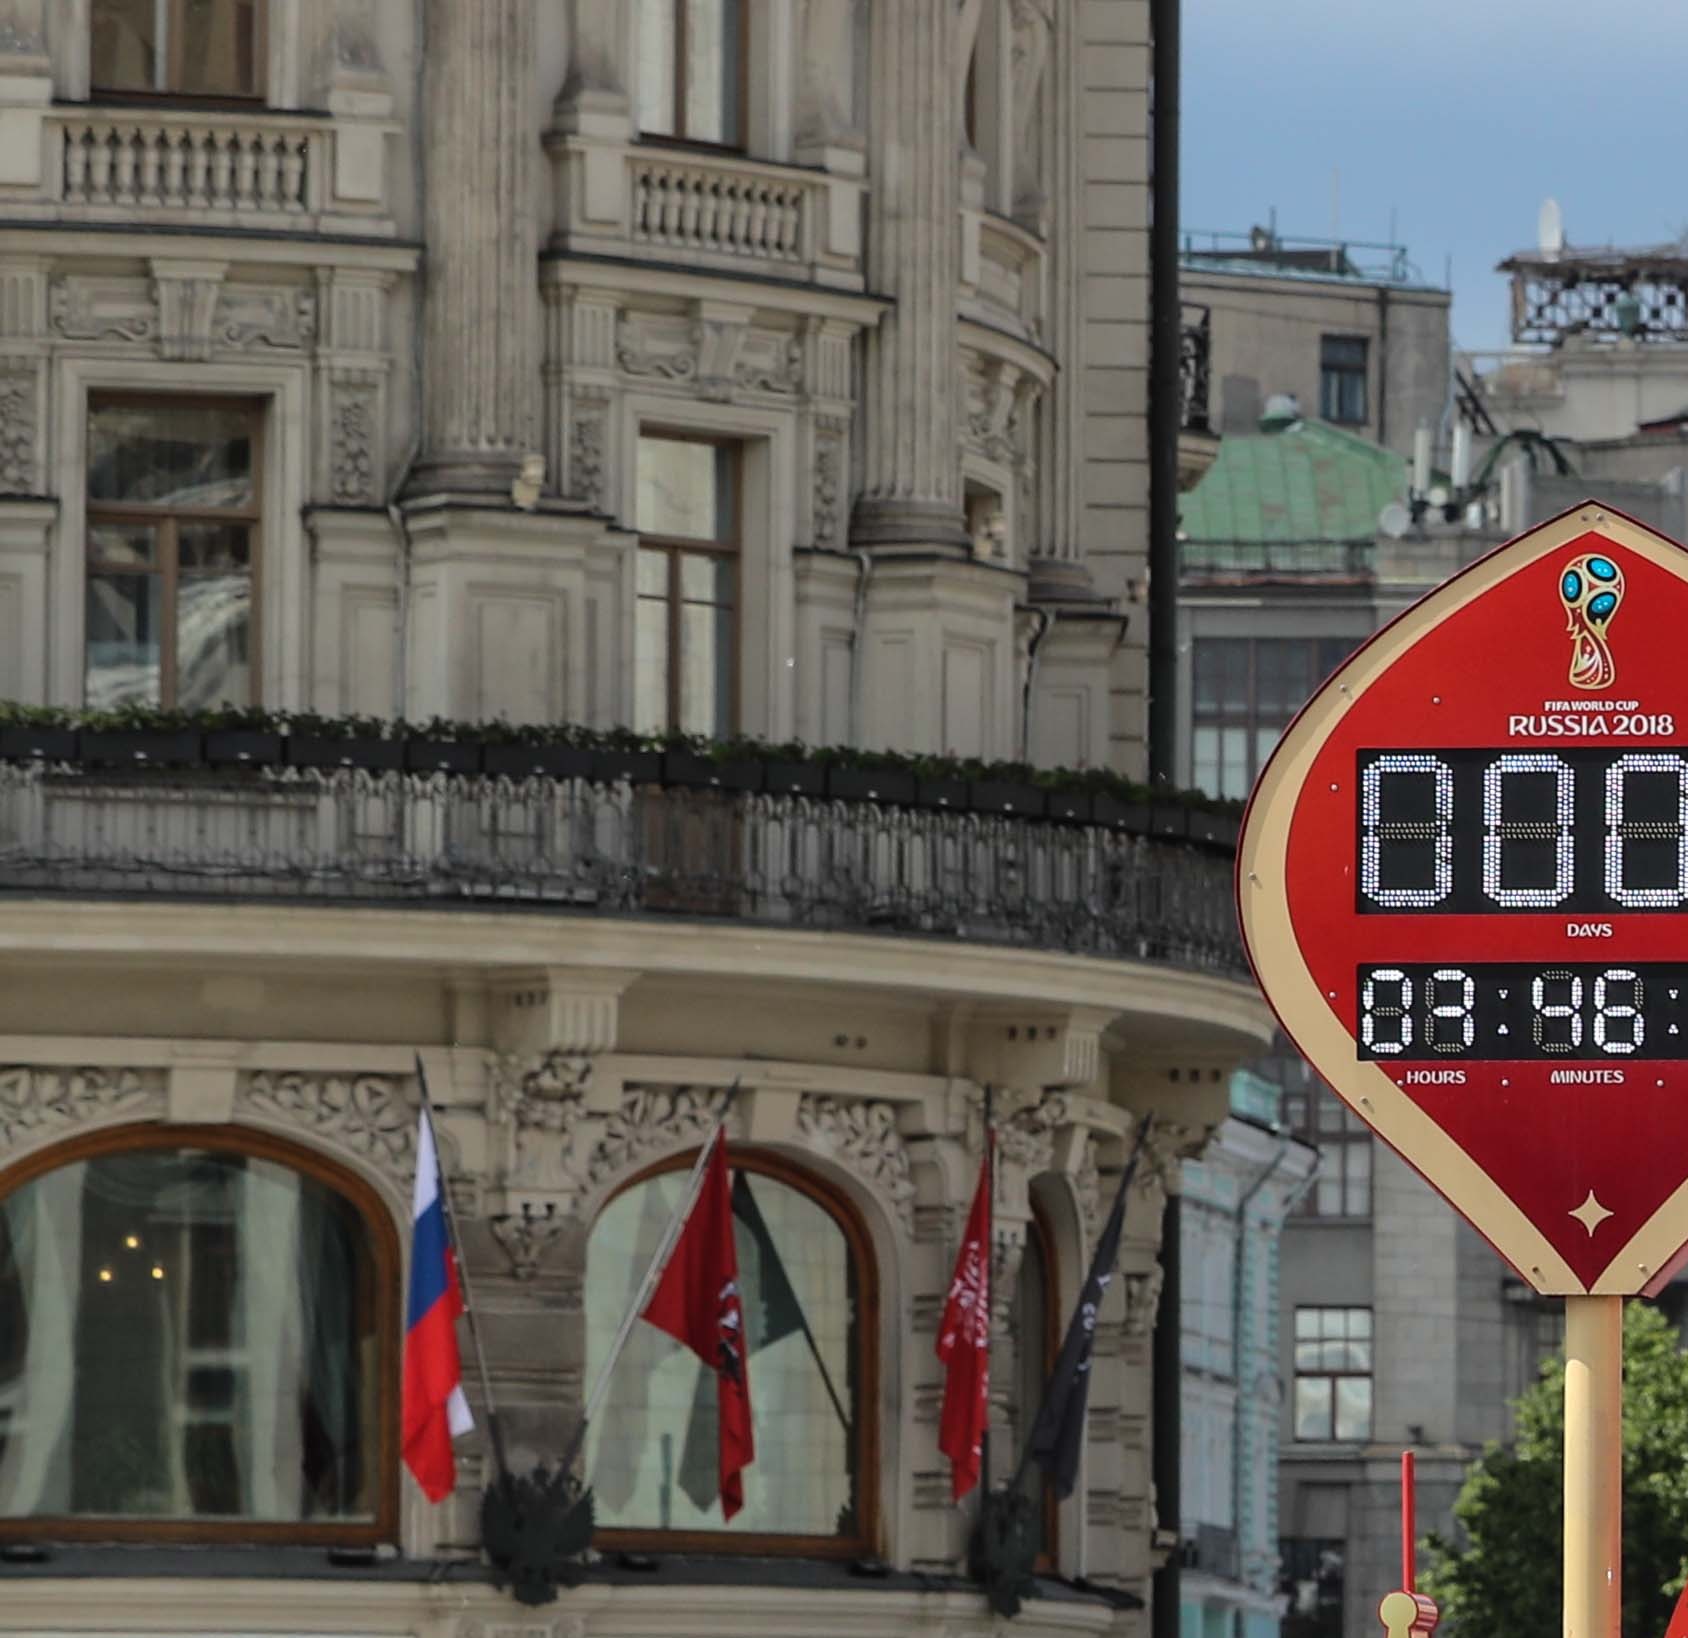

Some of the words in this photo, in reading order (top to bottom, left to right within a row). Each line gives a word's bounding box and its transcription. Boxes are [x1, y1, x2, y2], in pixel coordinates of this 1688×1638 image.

[1544, 701, 1571, 712] FIFA
[1571, 701, 1614, 712] WORLD
[1615, 701, 1639, 712] CUP
[1509, 715, 1609, 736] RUSSIA
[1612, 714, 1675, 736] 2018
[1567, 922, 1613, 938] DAYS
[1406, 1070, 1466, 1085] HOURS
[1550, 1070, 1625, 1085] MINUTES
